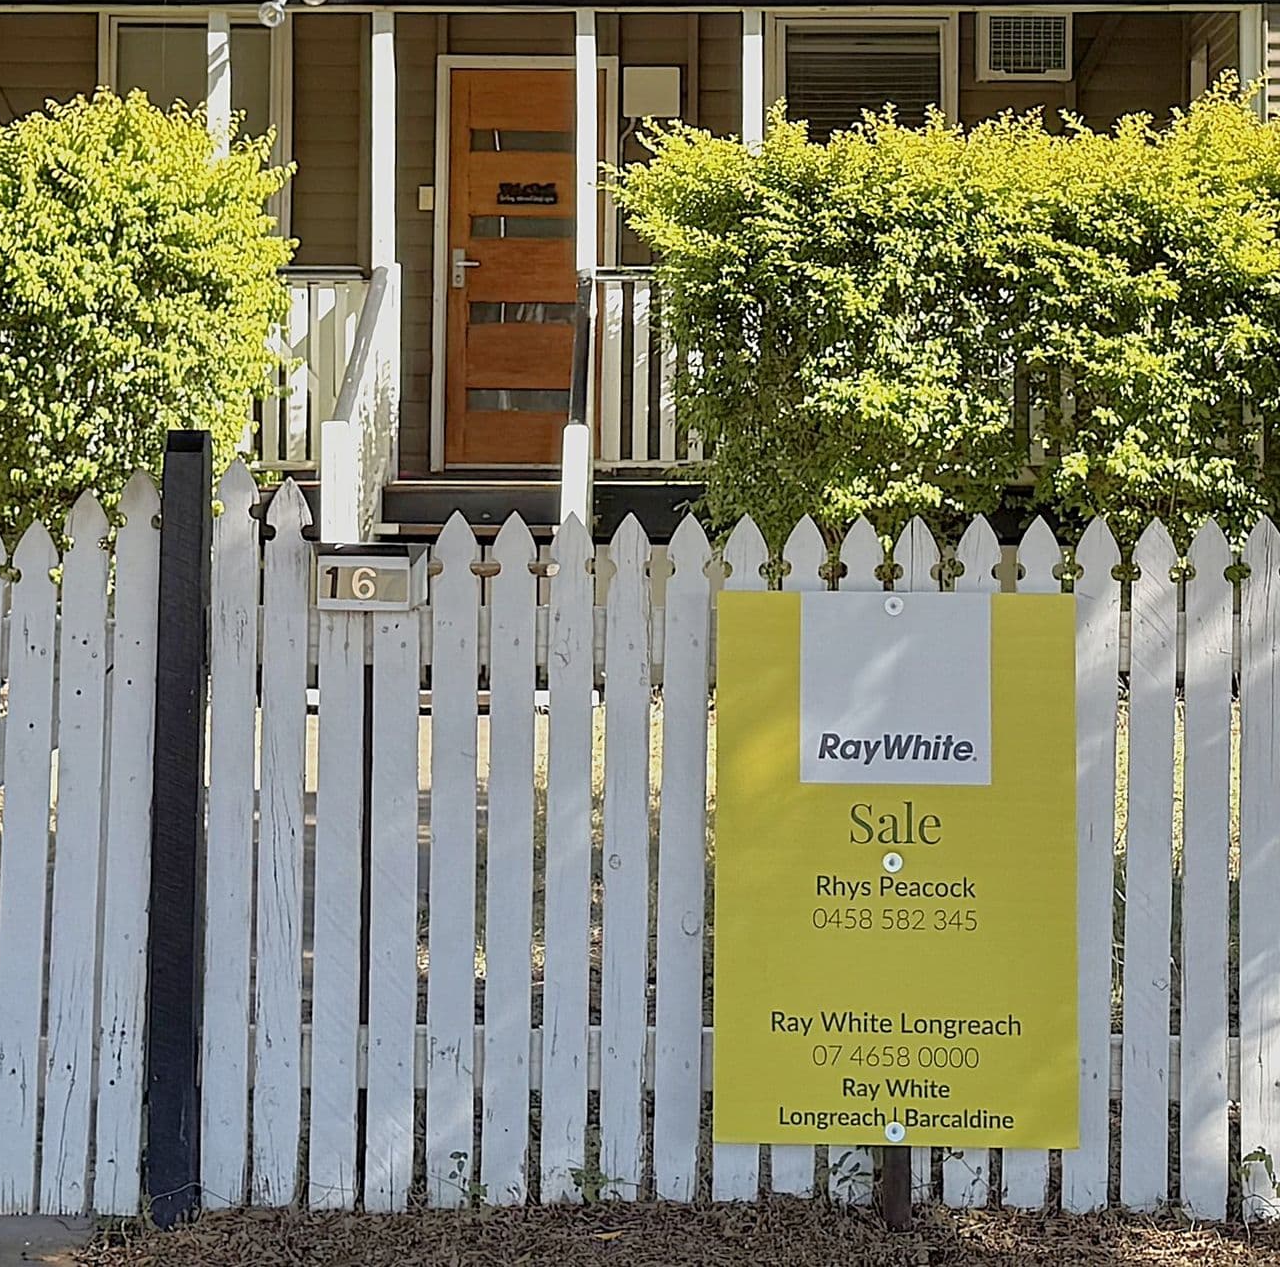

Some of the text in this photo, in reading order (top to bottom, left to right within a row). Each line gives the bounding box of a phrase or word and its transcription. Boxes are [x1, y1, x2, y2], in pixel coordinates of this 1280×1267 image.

[325, 566, 377, 600] 16
[850, 801, 942, 845] Sale
[816, 875, 976, 901] Rhys Peacock
[812, 907, 978, 932] 0458 582 345
[771, 1011, 1022, 1038] Ray White Longreach
[812, 1045, 980, 1069] 07 4658 0000
[842, 1078, 950, 1101] Ray White
[778, 1106, 886, 1129] Longreach
[905, 1108, 1014, 1129] Barcaldine
